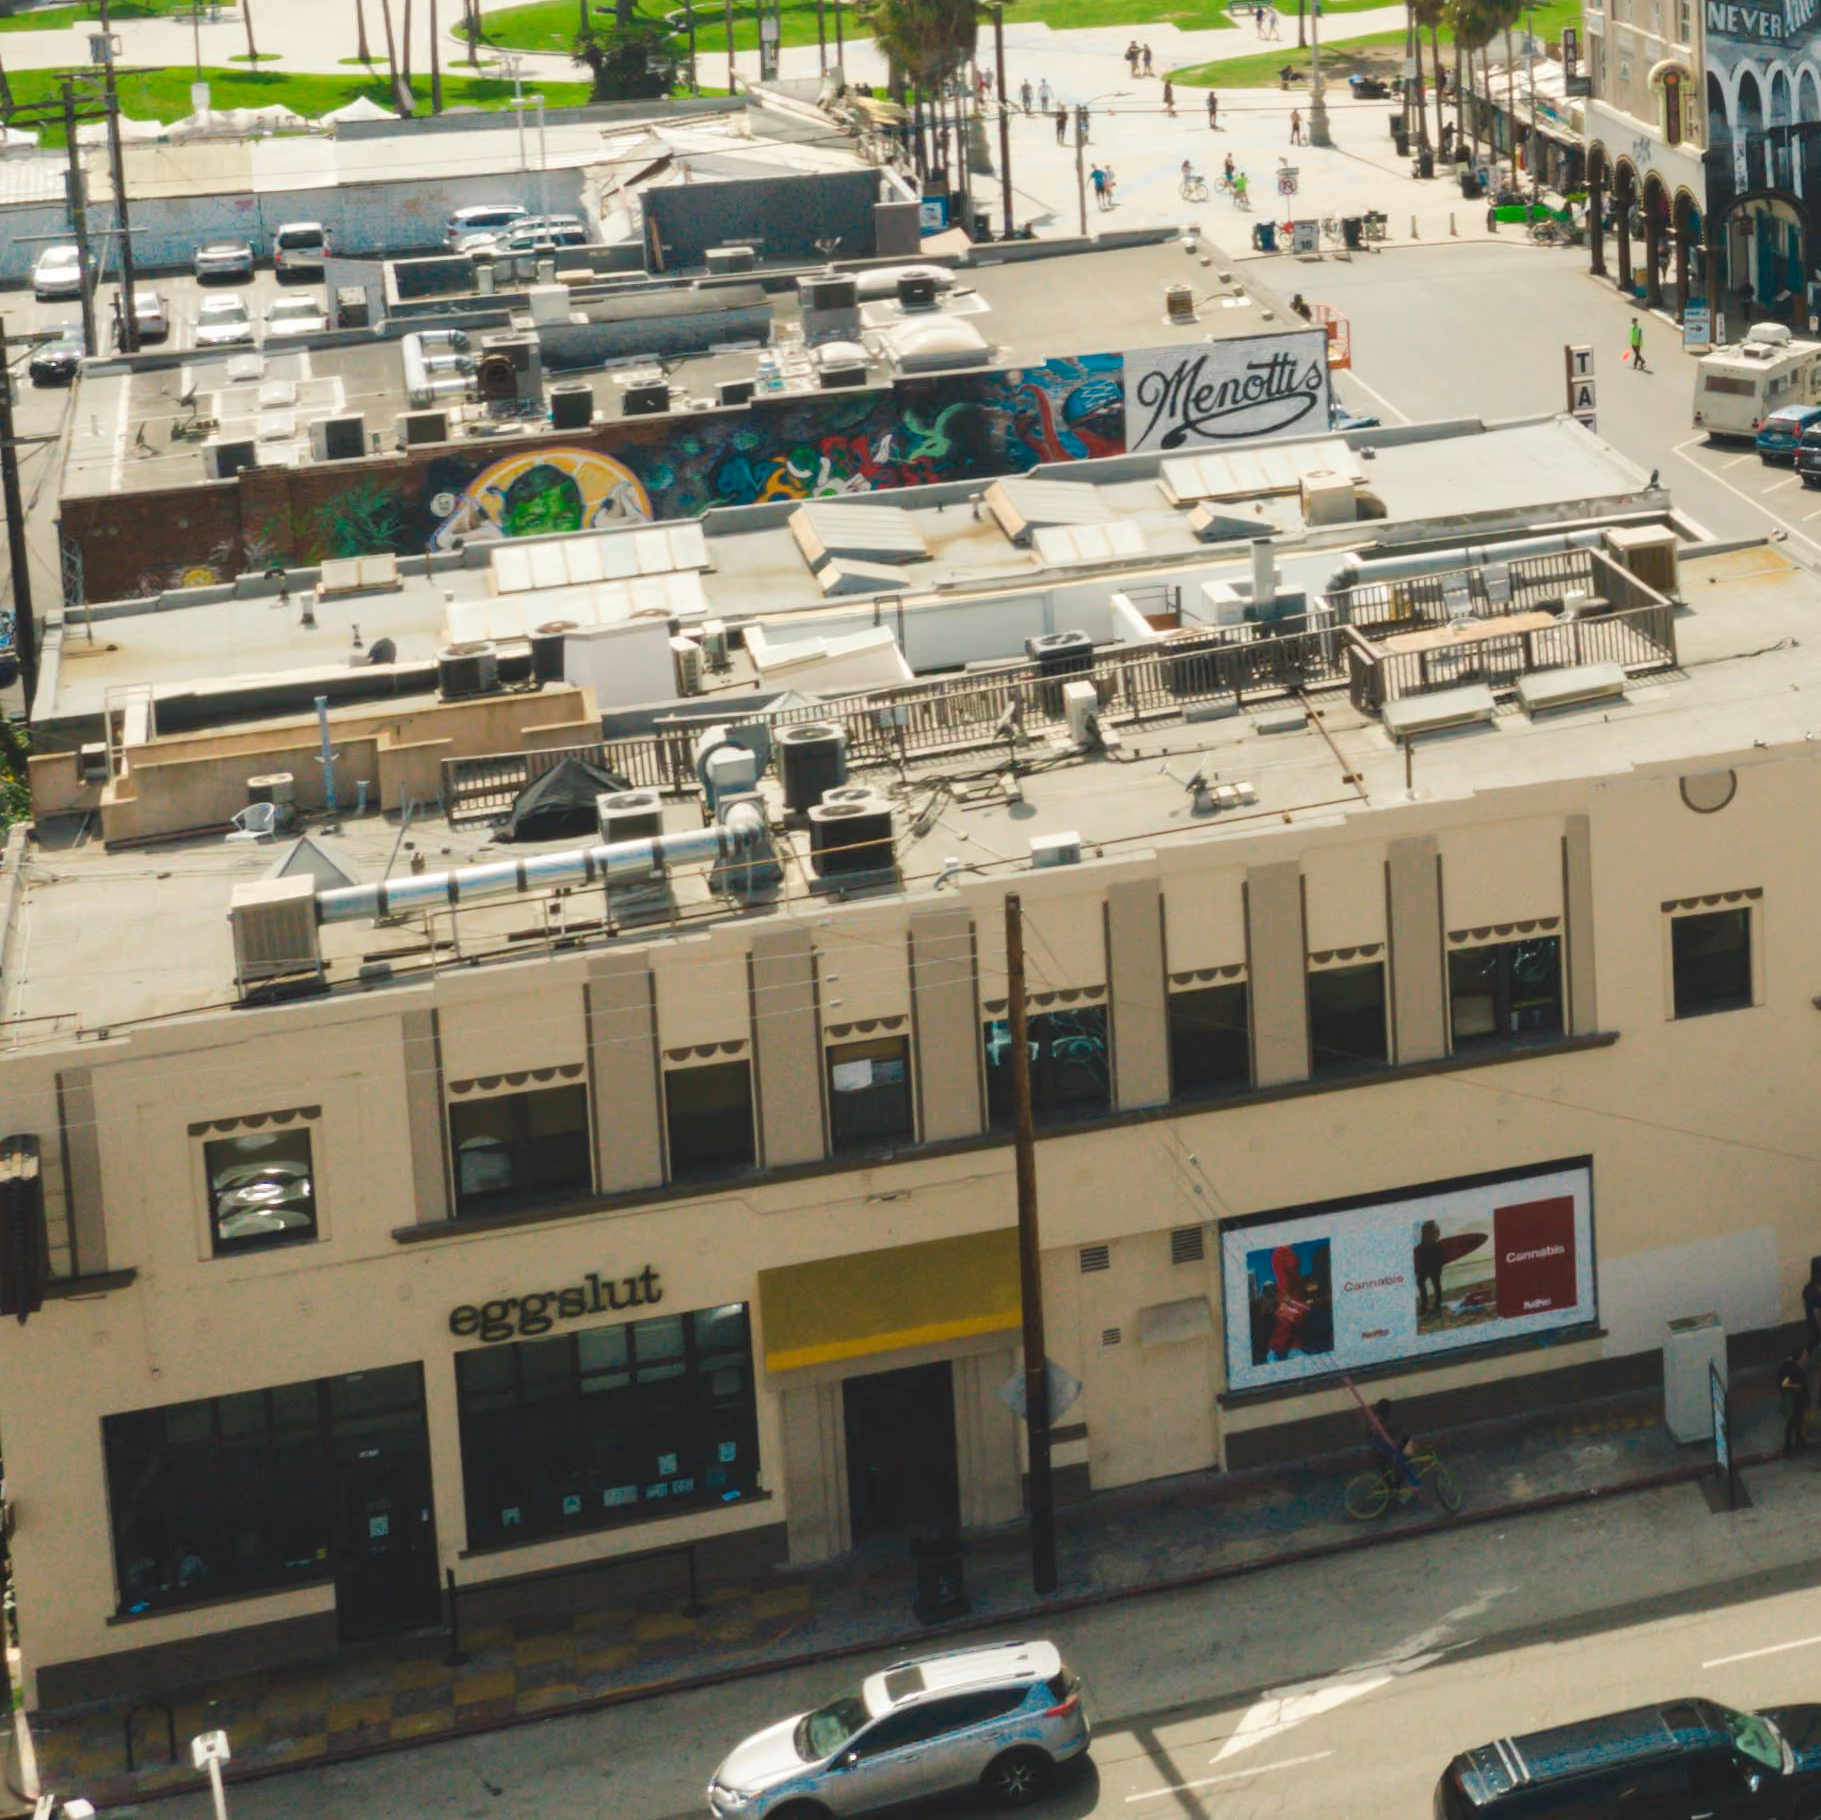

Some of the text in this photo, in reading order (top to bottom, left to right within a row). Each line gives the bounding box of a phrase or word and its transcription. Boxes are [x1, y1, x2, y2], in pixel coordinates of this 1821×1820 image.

[1707, 2, 1783, 38] NEVER
[1506, 1244, 1565, 1264] Cannabis
[1343, 1274, 1405, 1292] Cannabis
[449, 1263, 663, 1342] eggslut
